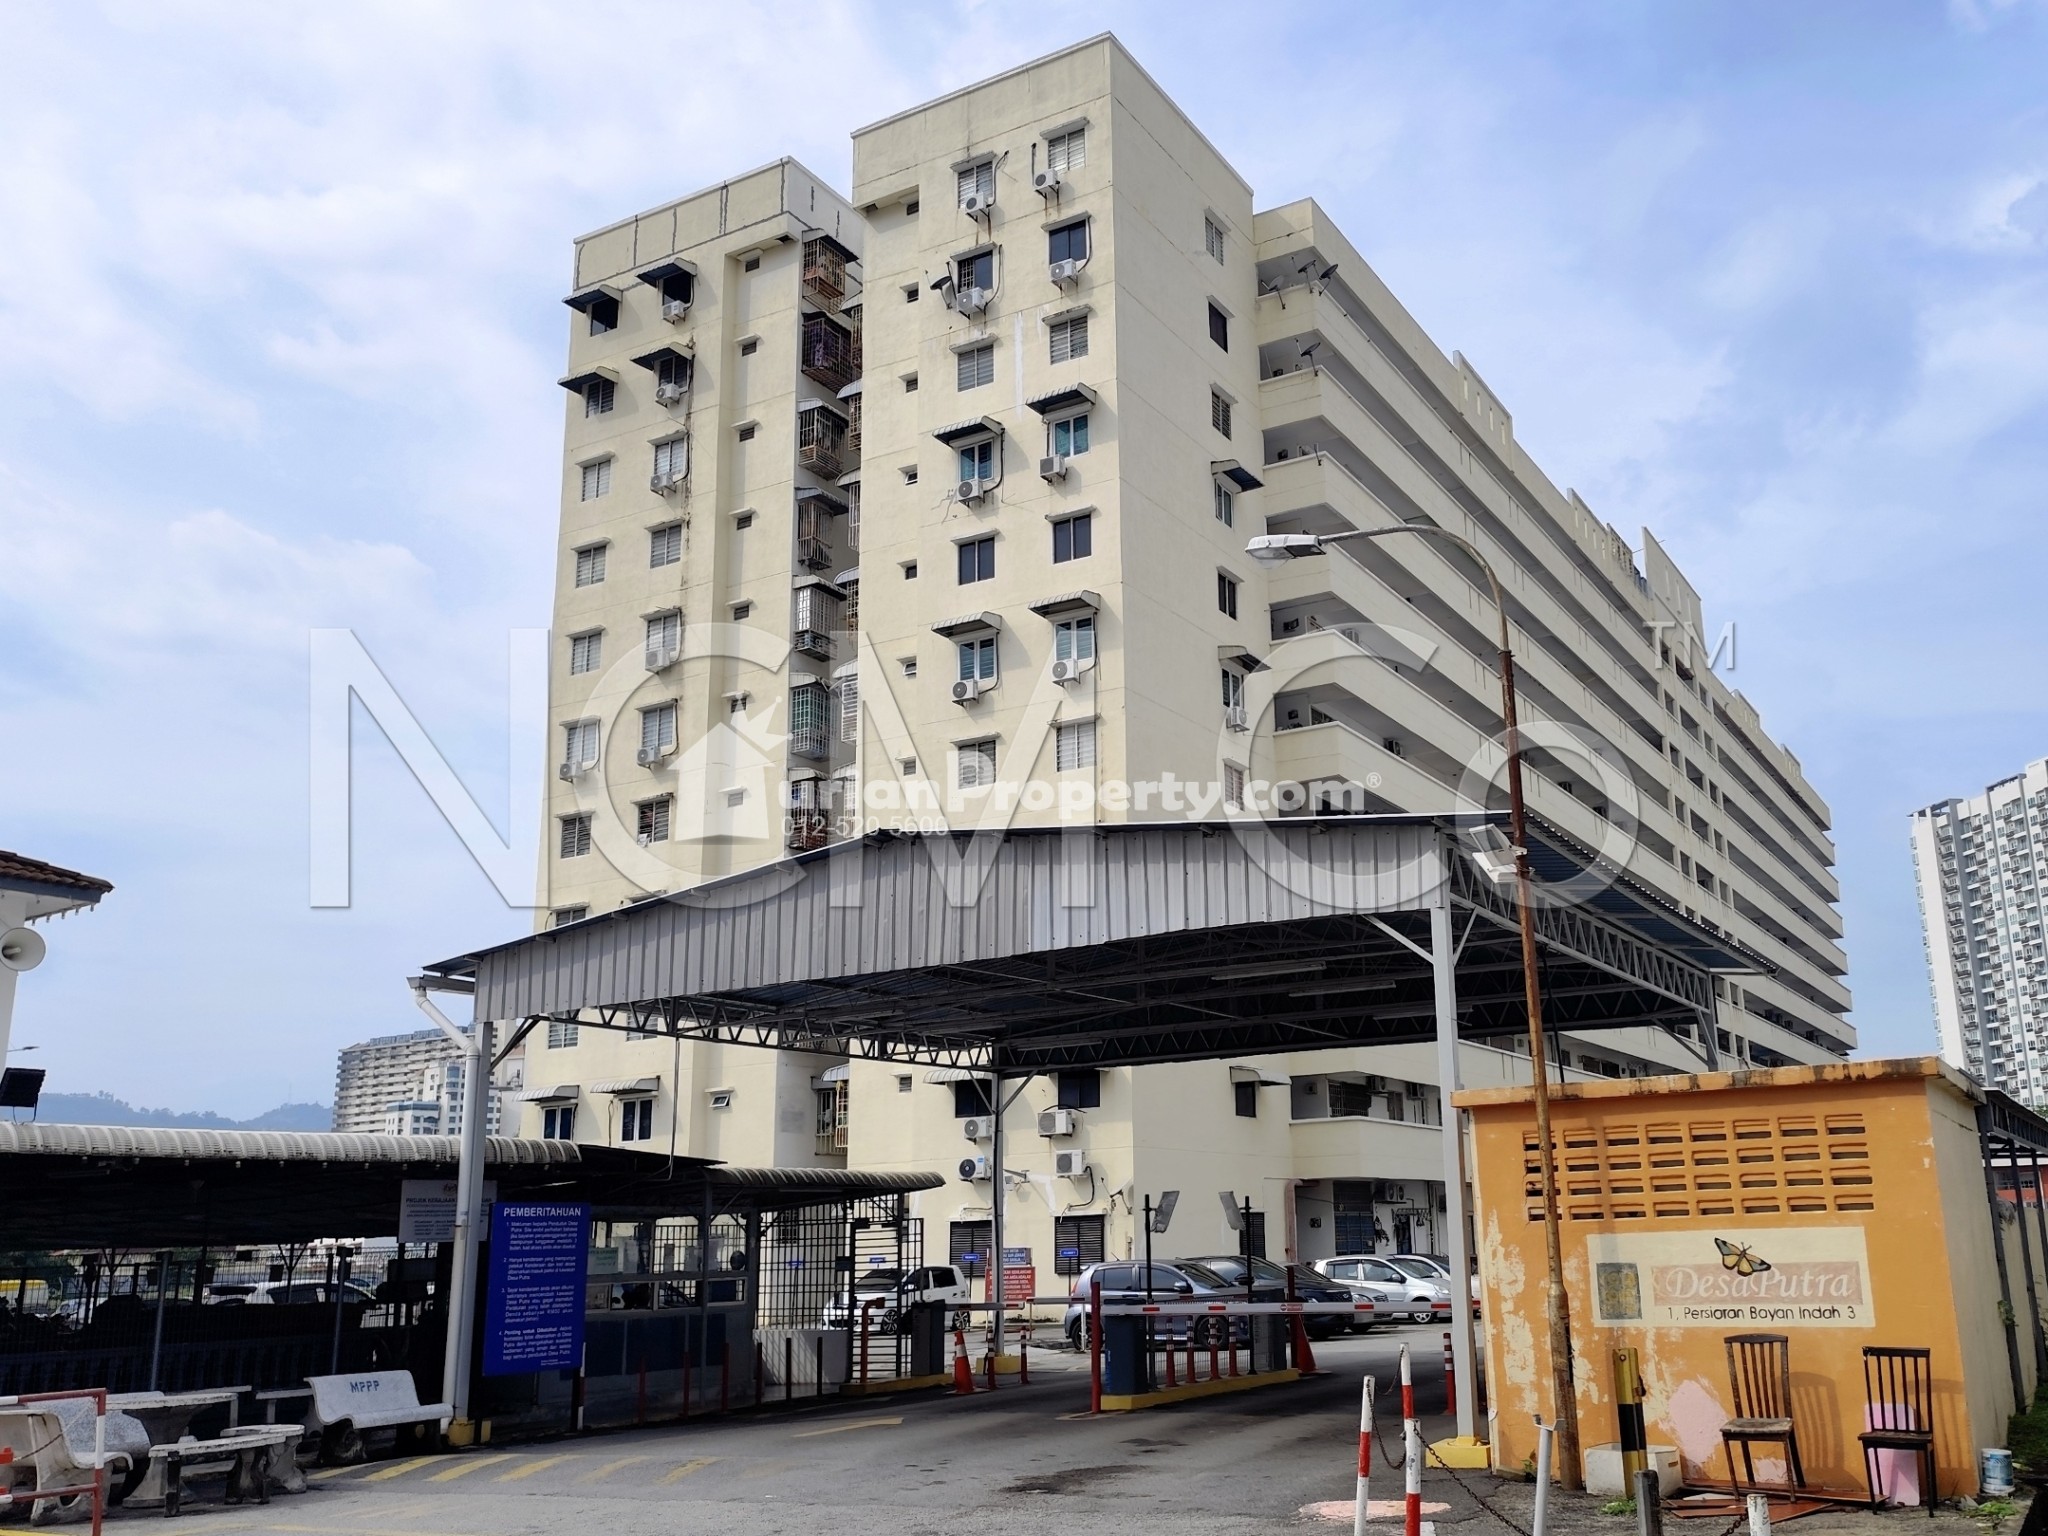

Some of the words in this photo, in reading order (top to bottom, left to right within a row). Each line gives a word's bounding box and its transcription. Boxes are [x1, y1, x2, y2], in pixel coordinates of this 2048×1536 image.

[503, 1207, 582, 1218] PEMBERITAHUAN
[1683, 1306, 1746, 1320] Persiaran
[1749, 1306, 1795, 1323] Bayan
[1799, 1305, 1841, 1320] Indah
[1847, 1305, 1857, 1320] 3
[349, 1380, 381, 1394] MPPP
